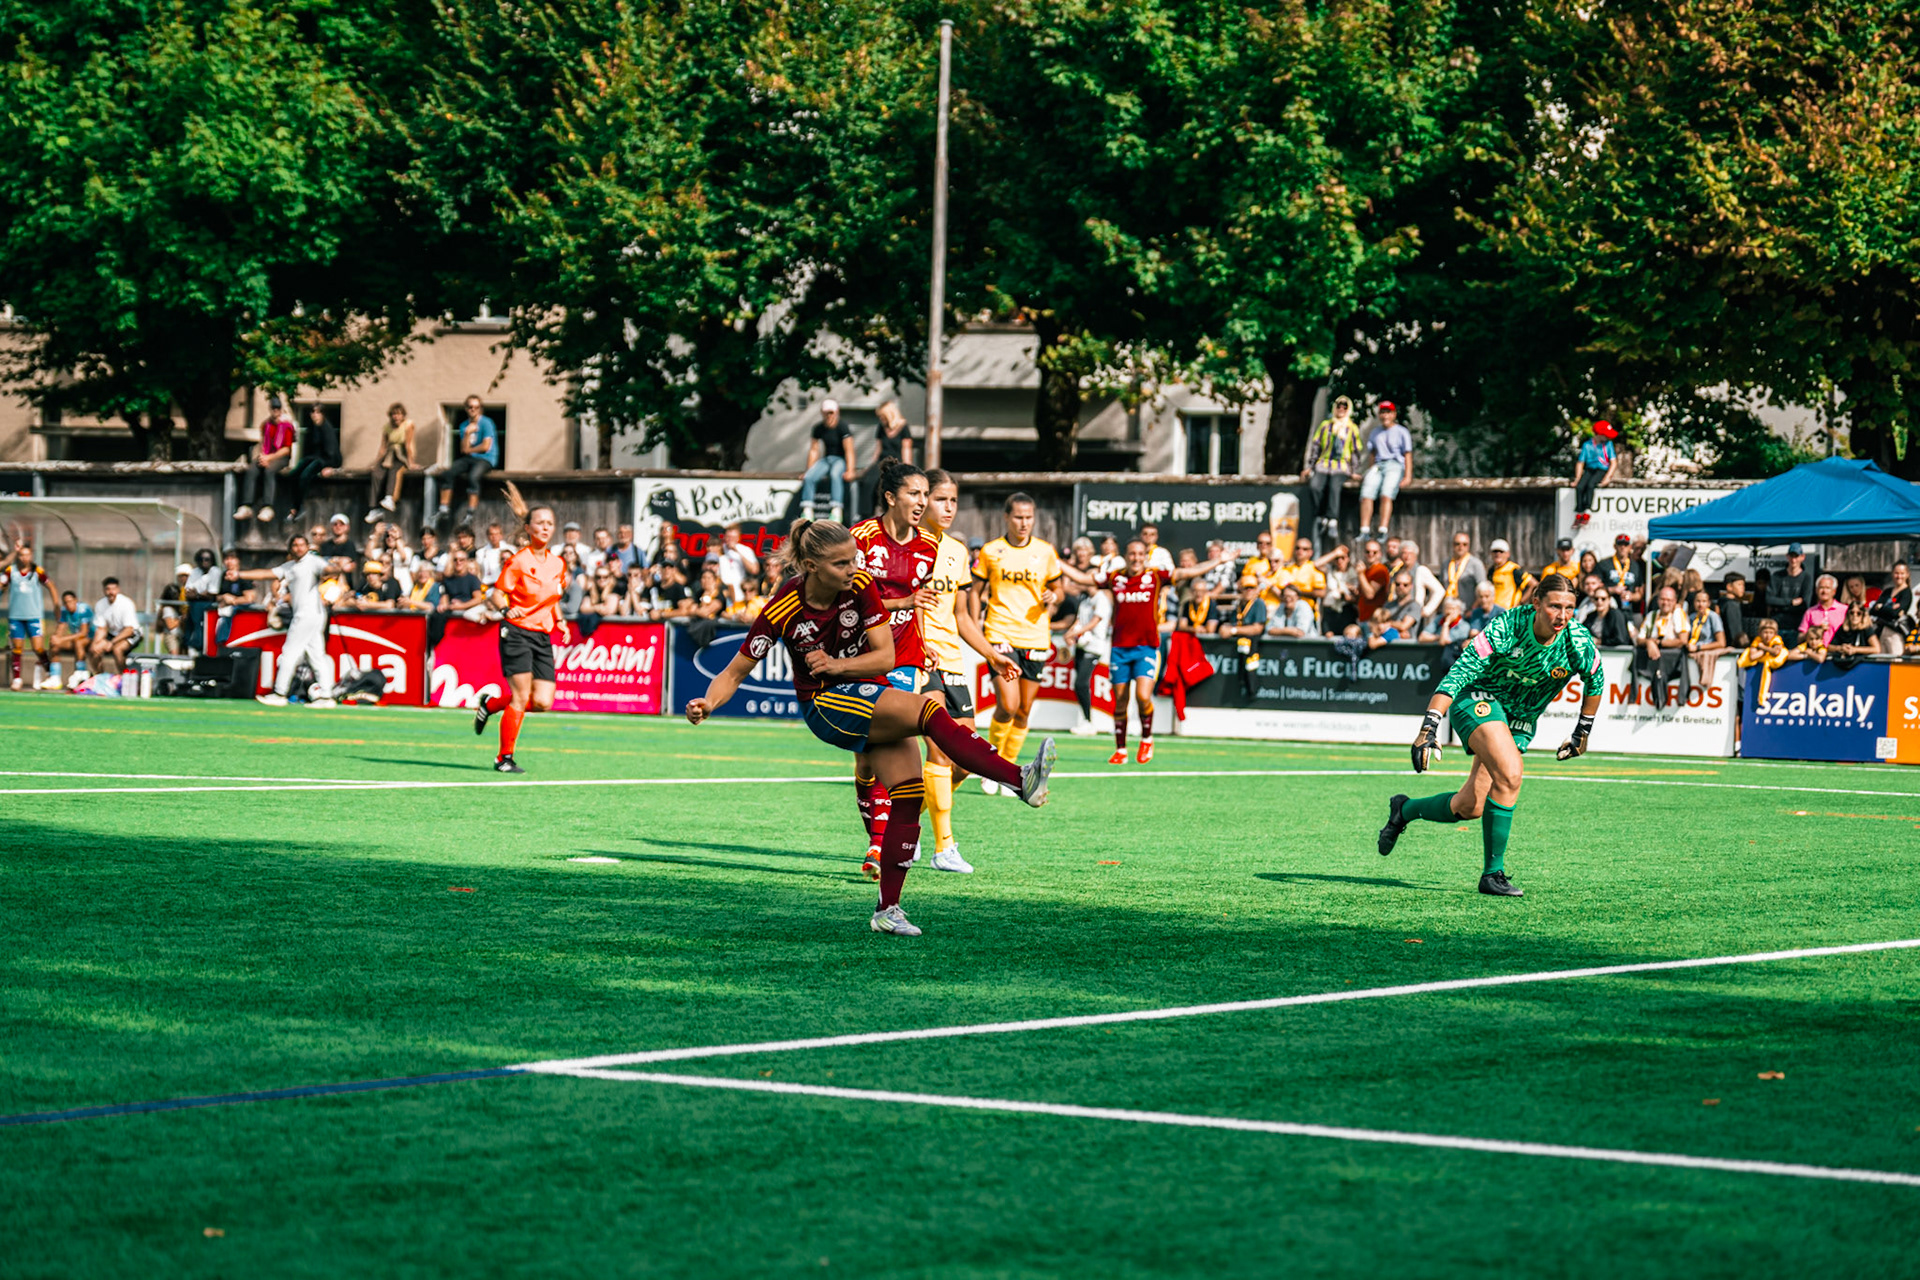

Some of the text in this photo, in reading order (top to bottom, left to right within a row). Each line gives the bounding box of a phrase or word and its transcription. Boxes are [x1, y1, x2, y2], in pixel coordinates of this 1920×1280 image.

[690, 485, 743, 516] Boss
[745, 500, 776, 517] Ball
[1087, 501, 1138, 525] SPITZ
[1141, 501, 1170, 522] UF
[1172, 501, 1211, 521] NES
[1214, 501, 1267, 524] BIER?
[922, 575, 959, 597] pt:
[1125, 591, 1152, 603] MSC
[792, 620, 820, 639] AXA
[552, 637, 658, 673] rdasini
[1283, 658, 1298, 677] &
[556, 672, 593, 683] MALER
[594, 673, 635, 685] GIPSER
[745, 699, 799, 715] GOUR
[1755, 683, 1876, 723] szakaly
[1902, 695, 1920, 720] s
